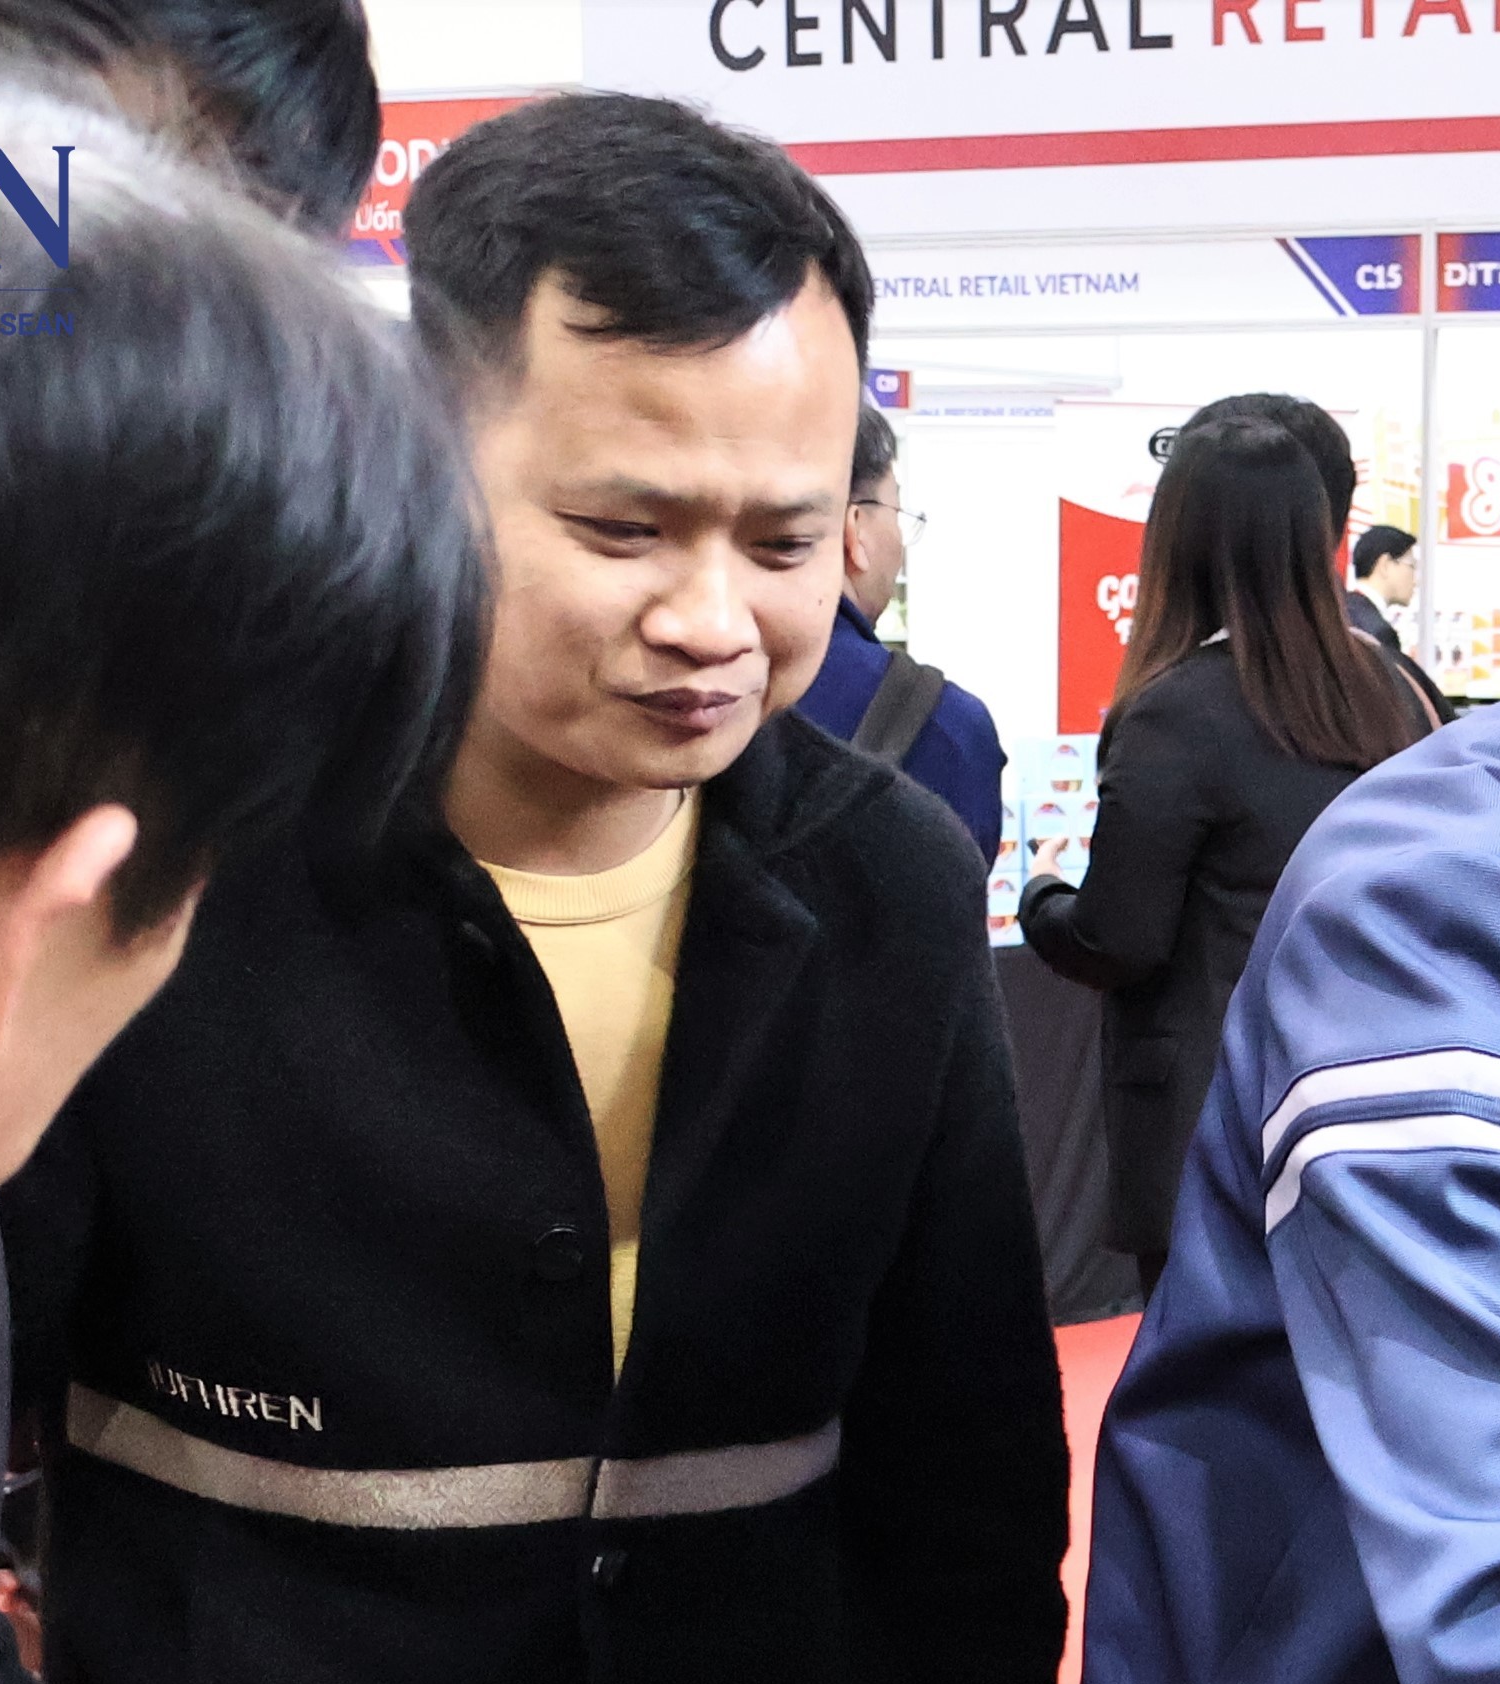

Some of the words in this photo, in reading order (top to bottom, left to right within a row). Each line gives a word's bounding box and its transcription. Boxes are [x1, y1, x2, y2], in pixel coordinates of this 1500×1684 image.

[710, 0, 1174, 71] CENTRAL
[870, 276, 952, 300] ENTRAL
[960, 274, 1031, 298] RETAIL
[1035, 272, 1139, 296] VIETNAM
[1356, 263, 1402, 290] C15
